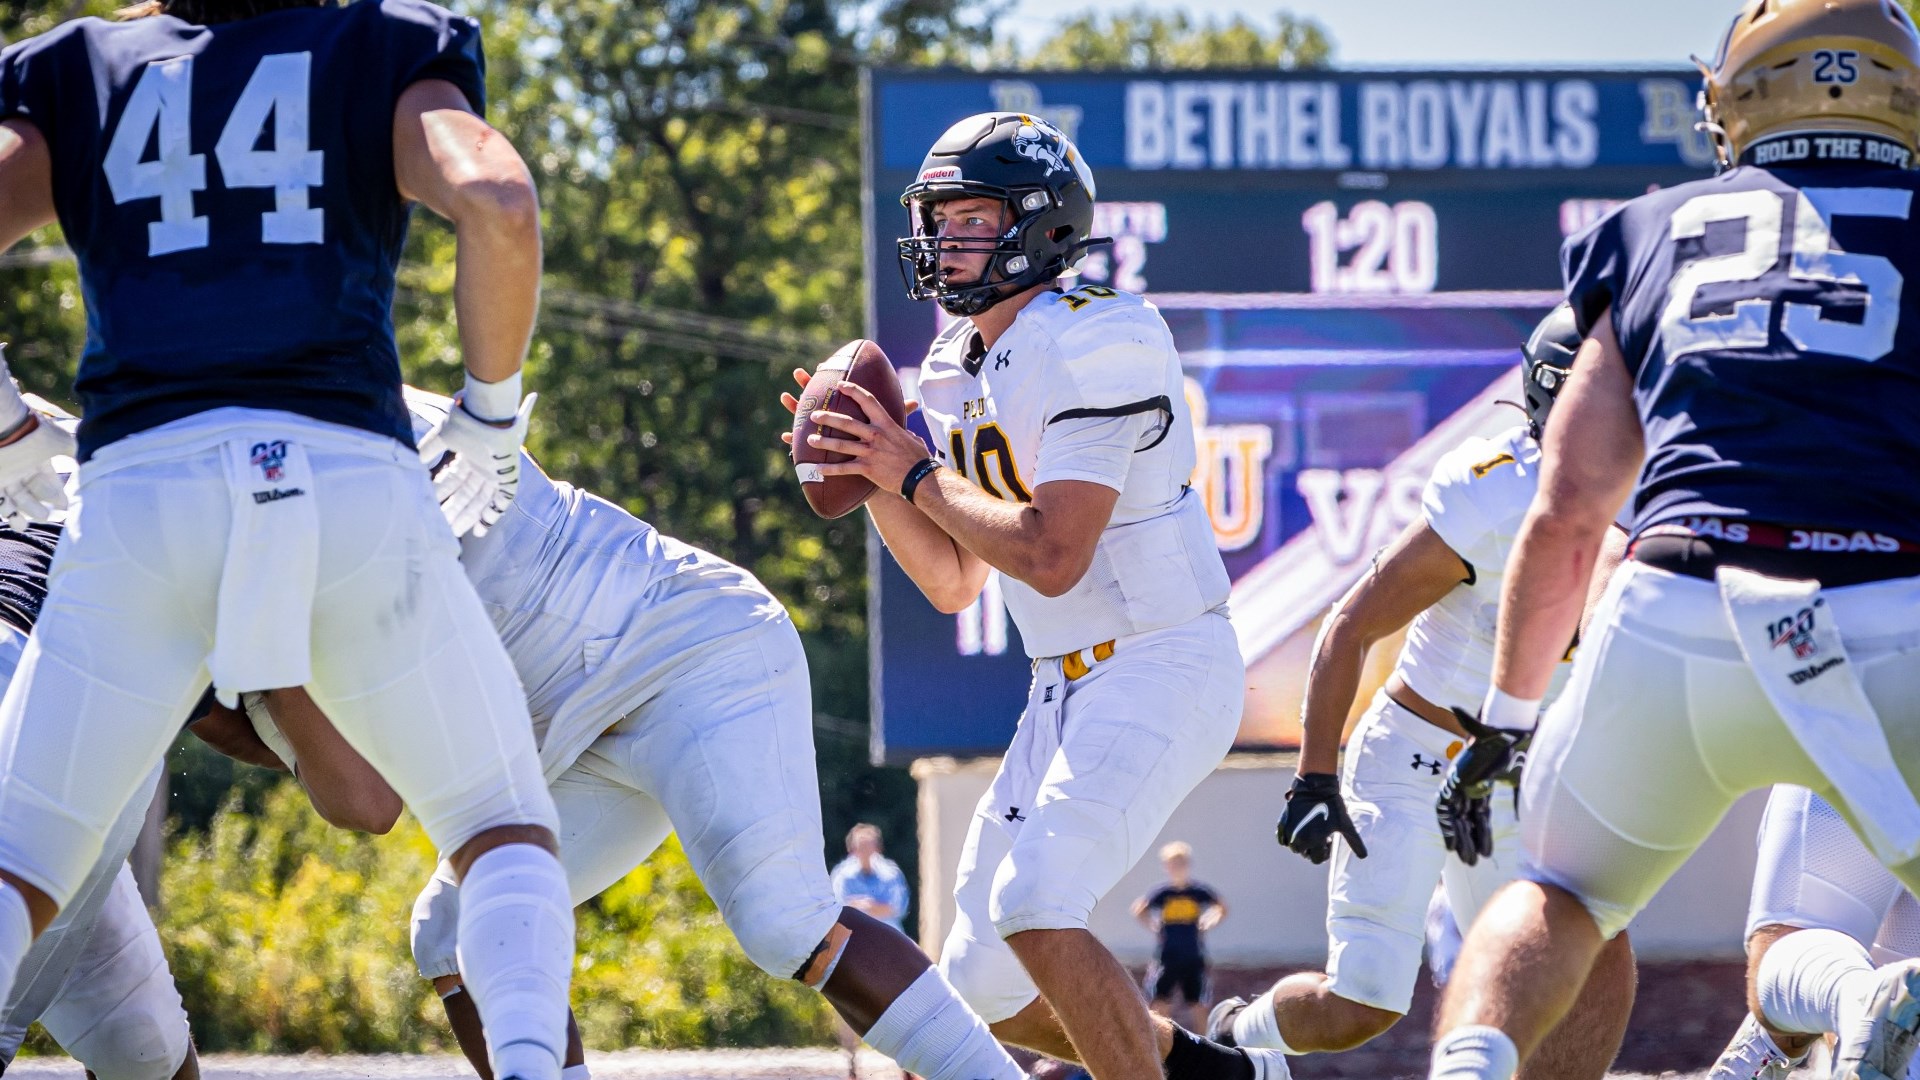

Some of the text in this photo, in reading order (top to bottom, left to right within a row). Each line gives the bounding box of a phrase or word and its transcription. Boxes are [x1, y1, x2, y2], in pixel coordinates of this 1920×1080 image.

[1811, 49, 1860, 84] 25
[103, 50, 325, 257] 44
[1125, 81, 1350, 170] BETHEL
[1358, 79, 1599, 169] ROYALS
[1754, 137, 1912, 170] HOLD THE ROPE
[1302, 199, 1439, 292] 1:20
[1661, 187, 1913, 364] 25
[1058, 285, 1119, 312] 10
[963, 397, 986, 420] PLU
[949, 420, 1032, 504] 10
